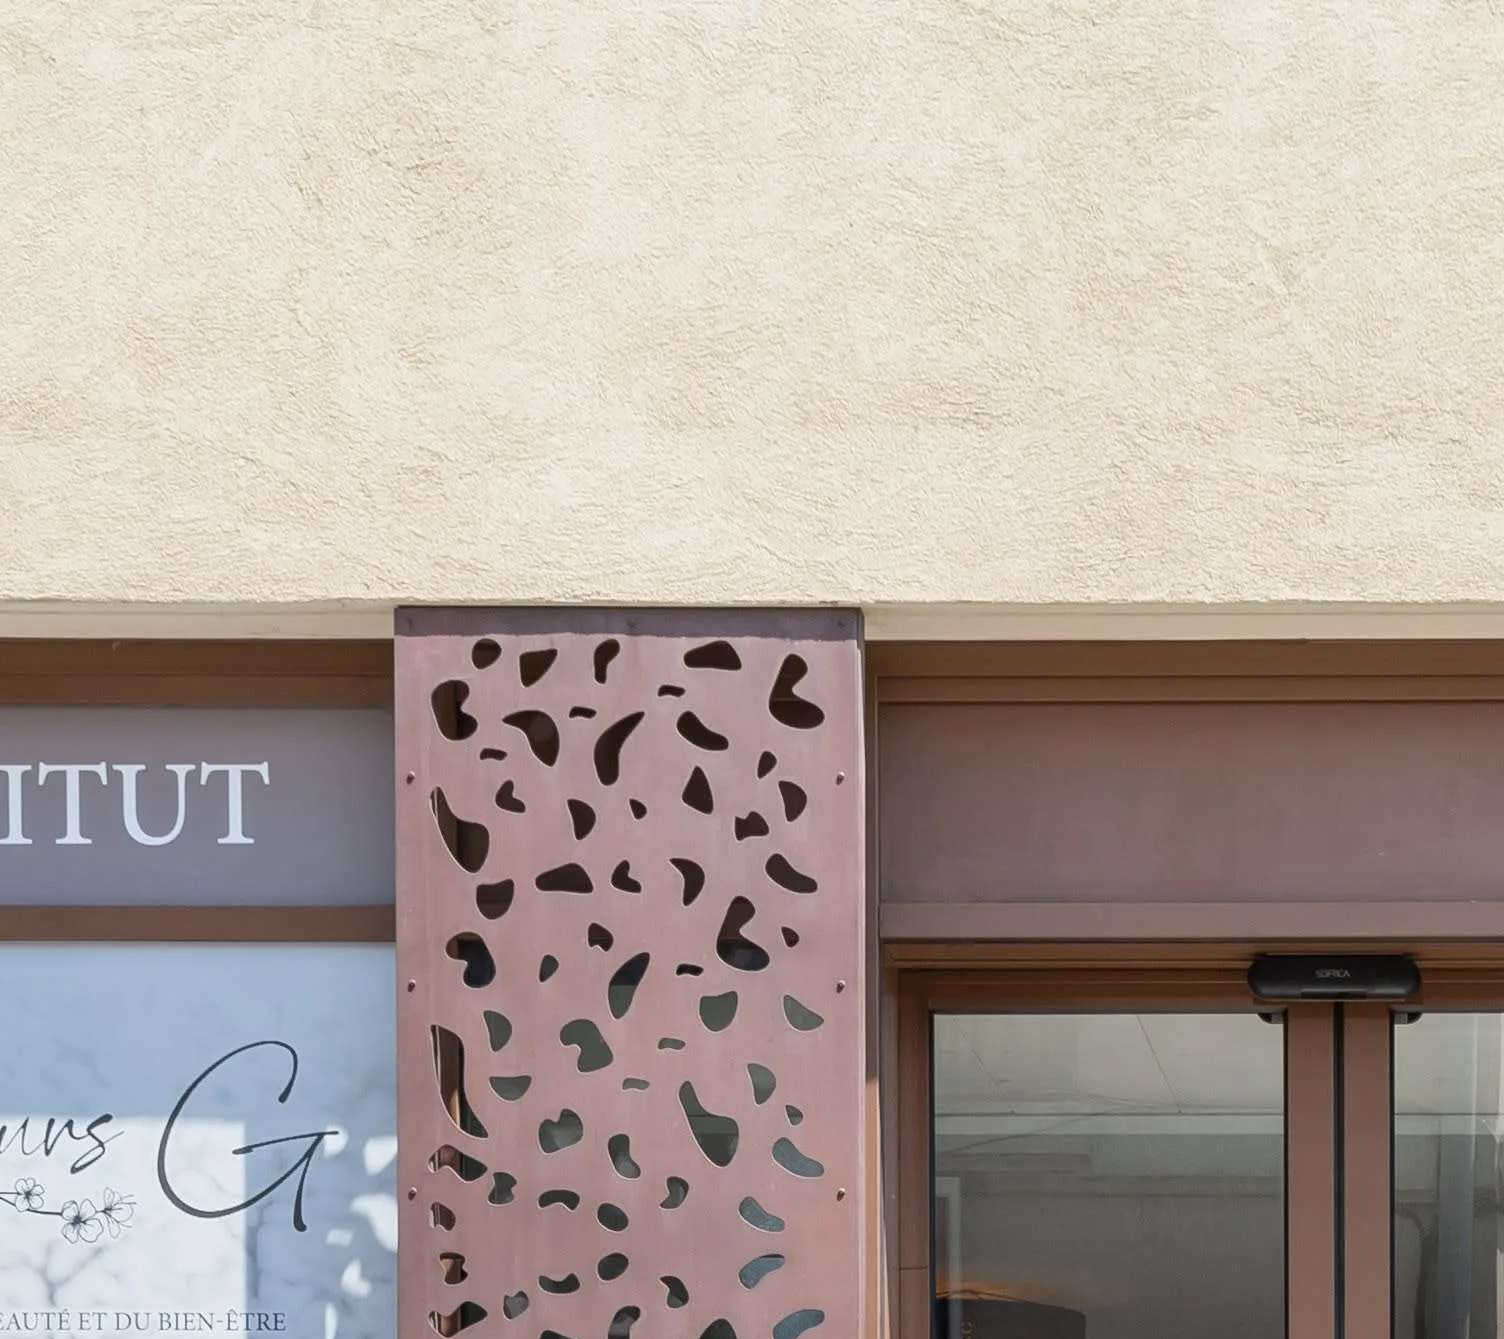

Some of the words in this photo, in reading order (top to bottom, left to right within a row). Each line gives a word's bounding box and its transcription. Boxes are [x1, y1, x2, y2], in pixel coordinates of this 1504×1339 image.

[157, 1040, 339, 1232] G
[78, 1312, 108, 1331] ET
[114, 1312, 151, 1331] DU
[158, 1305, 287, 1332] BIEN-ÊTRE
